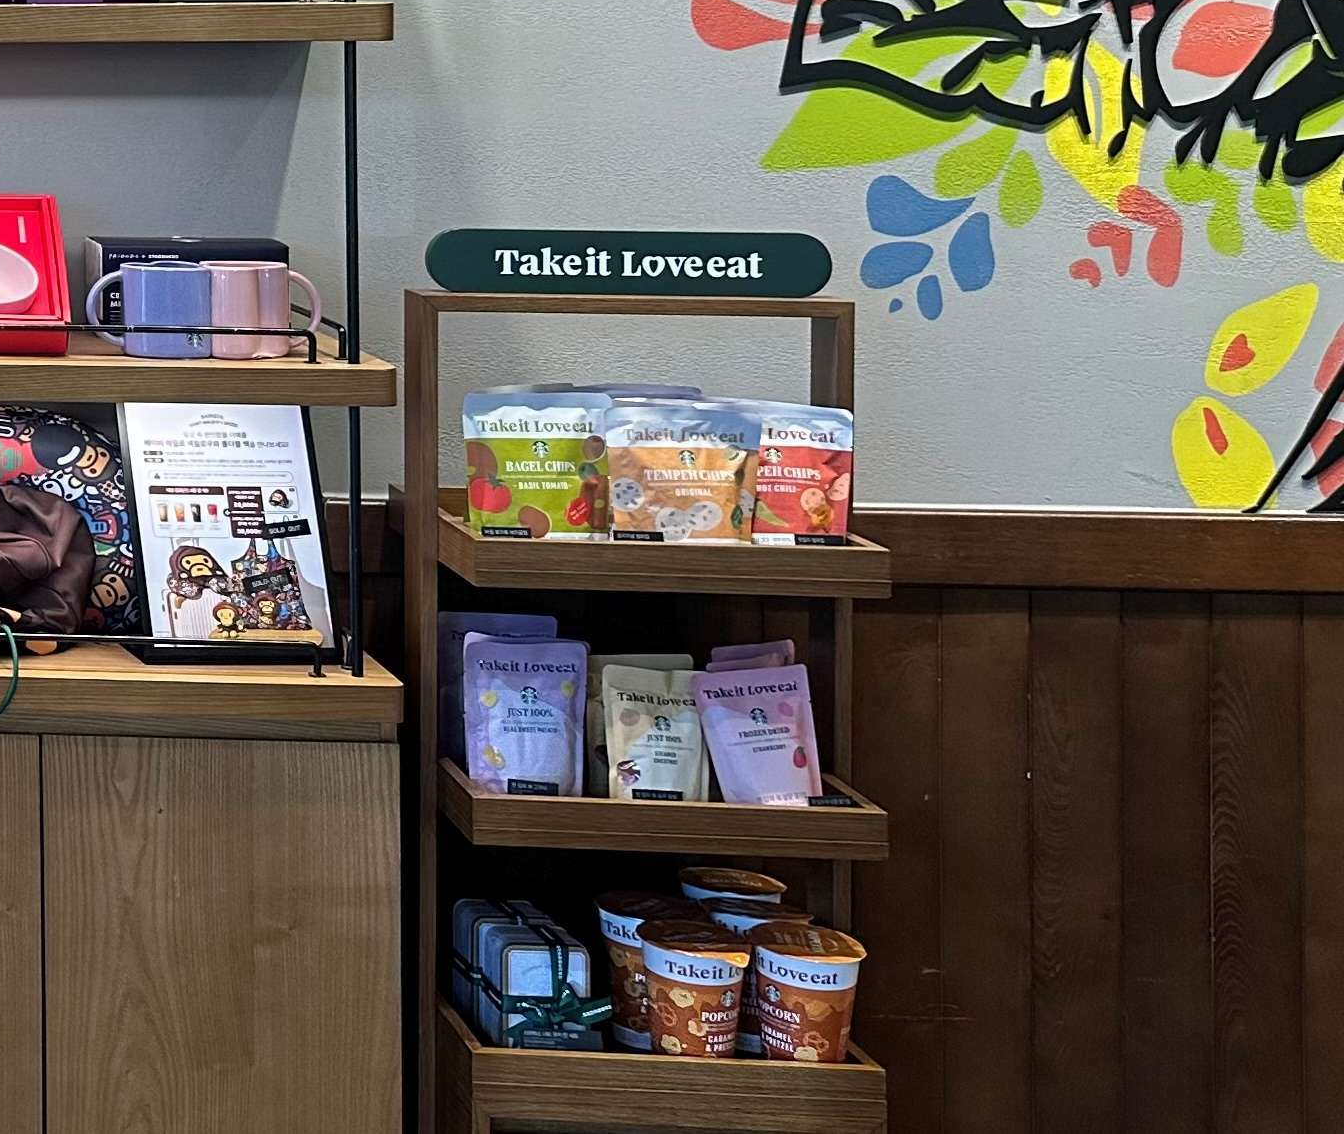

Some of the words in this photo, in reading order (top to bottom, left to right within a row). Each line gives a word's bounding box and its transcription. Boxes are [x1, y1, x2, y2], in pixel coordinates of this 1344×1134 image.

[505, 461, 544, 473] BAGEL
[545, 460, 576, 473] CHIPS
[644, 469, 697, 482] TEMPEH
[698, 469, 736, 482] CHIPS
[789, 468, 822, 481] CHIPS
[518, 482, 540, 490] BASIL
[541, 482, 569, 490] TOMATO
[675, 488, 713, 497] ORIGINAL
[268, 526, 286, 535] SOLD
[507, 708, 529, 718] JUST
[530, 708, 554, 717] 100%
[647, 734, 664, 743] JUST
[738, 729, 766, 739] FROZEN
